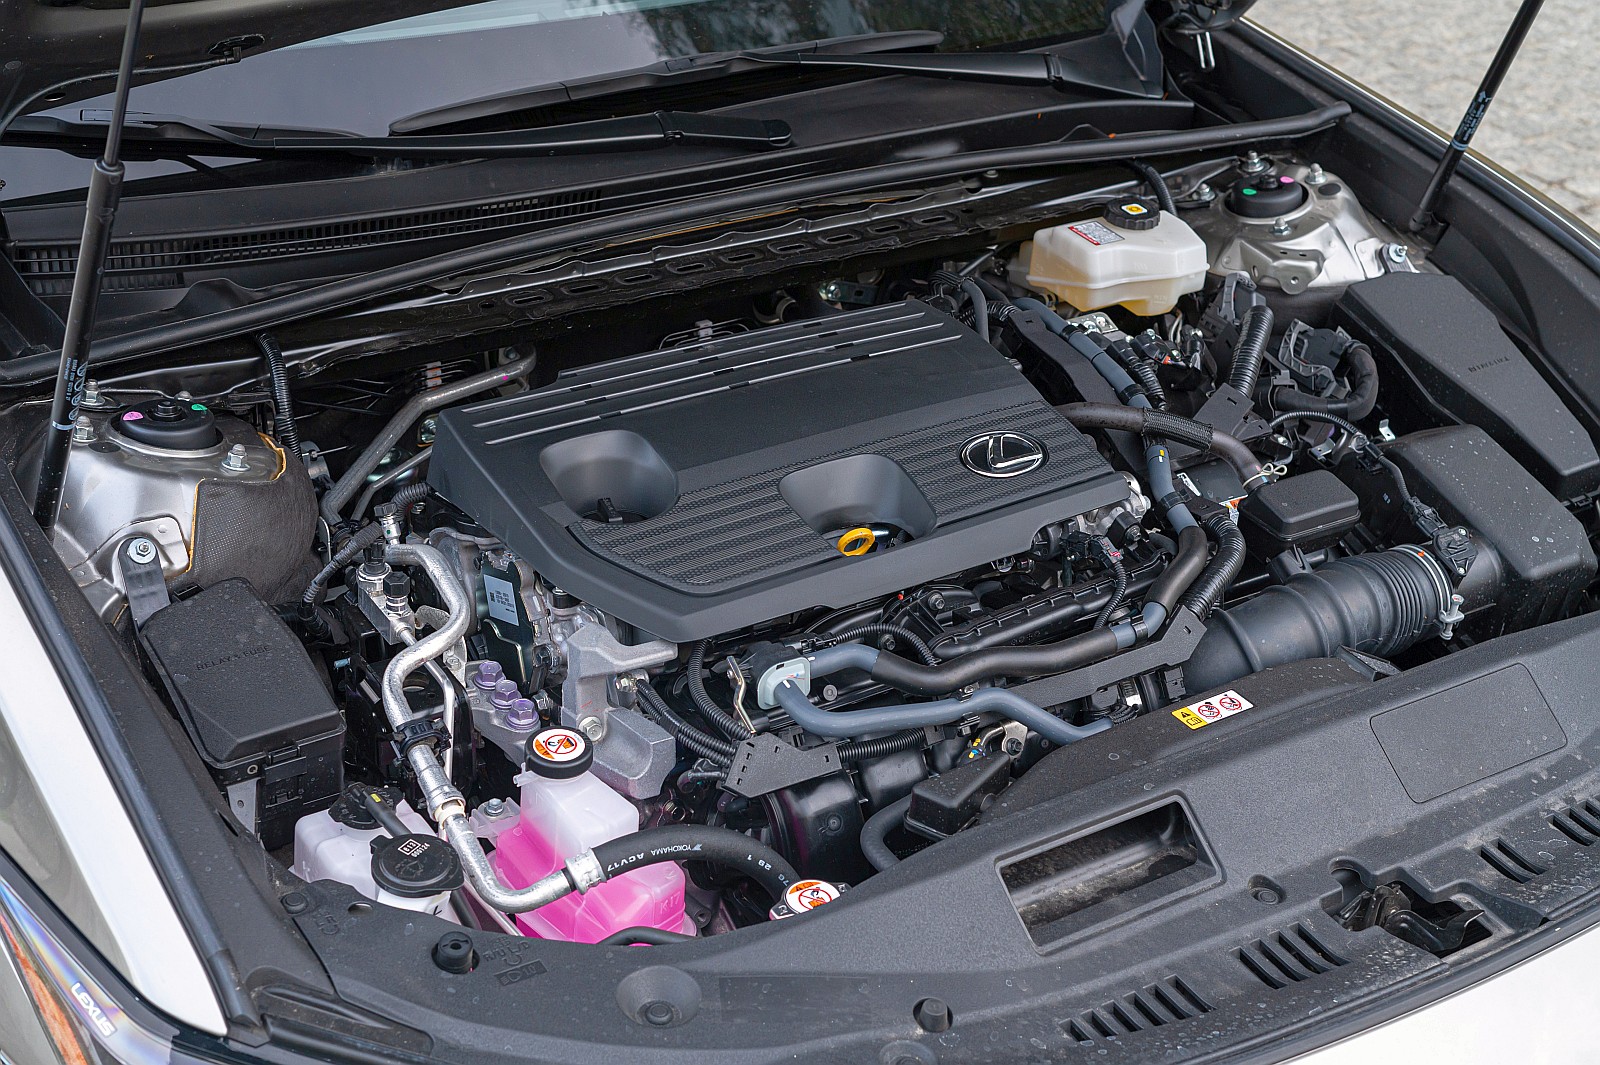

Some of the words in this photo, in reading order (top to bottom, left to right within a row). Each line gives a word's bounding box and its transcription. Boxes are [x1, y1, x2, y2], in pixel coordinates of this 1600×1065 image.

[195, 656, 231, 671] RELAY
[243, 645, 270, 657] FUSE
[650, 844, 692, 856] YOKOHAMA
[607, 852, 645, 872] ACV17
[71, 982, 117, 1037] LEXUS
